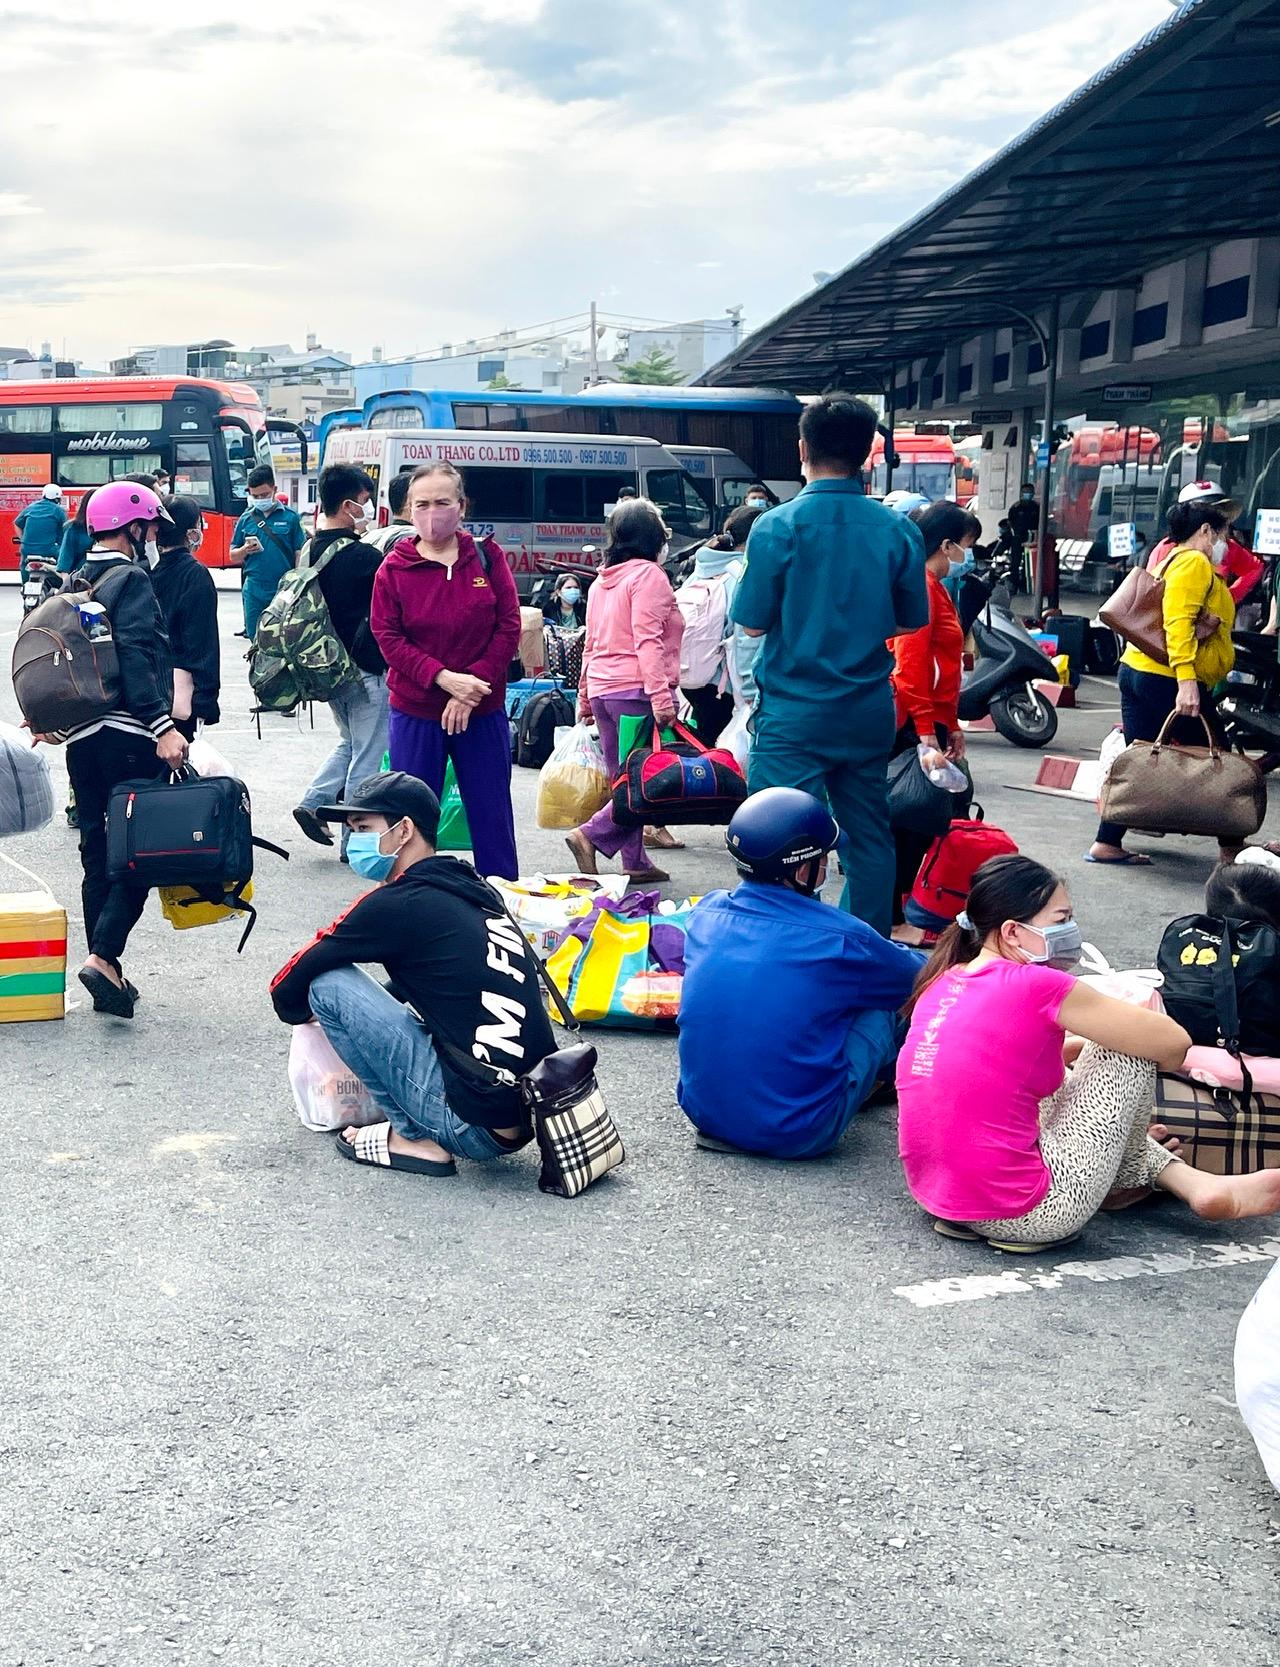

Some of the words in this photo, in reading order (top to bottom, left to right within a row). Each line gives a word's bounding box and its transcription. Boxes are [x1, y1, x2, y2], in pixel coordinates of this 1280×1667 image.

[67, 432, 151, 451] mobihome
[402, 444, 432, 460] TOAN
[436, 445, 475, 461] THANG
[479, 447, 521, 463] CO.,LTD
[523, 448, 573, 464] 0996.500.500
[580, 449, 628, 466] 0997.500.500
[462, 523, 494, 537] 3.73
[536, 524, 558, 536] TOAN
[560, 524, 586, 536] THANG
[504, 545, 547, 573] OÀN
[485, 907, 527, 985] FIN
